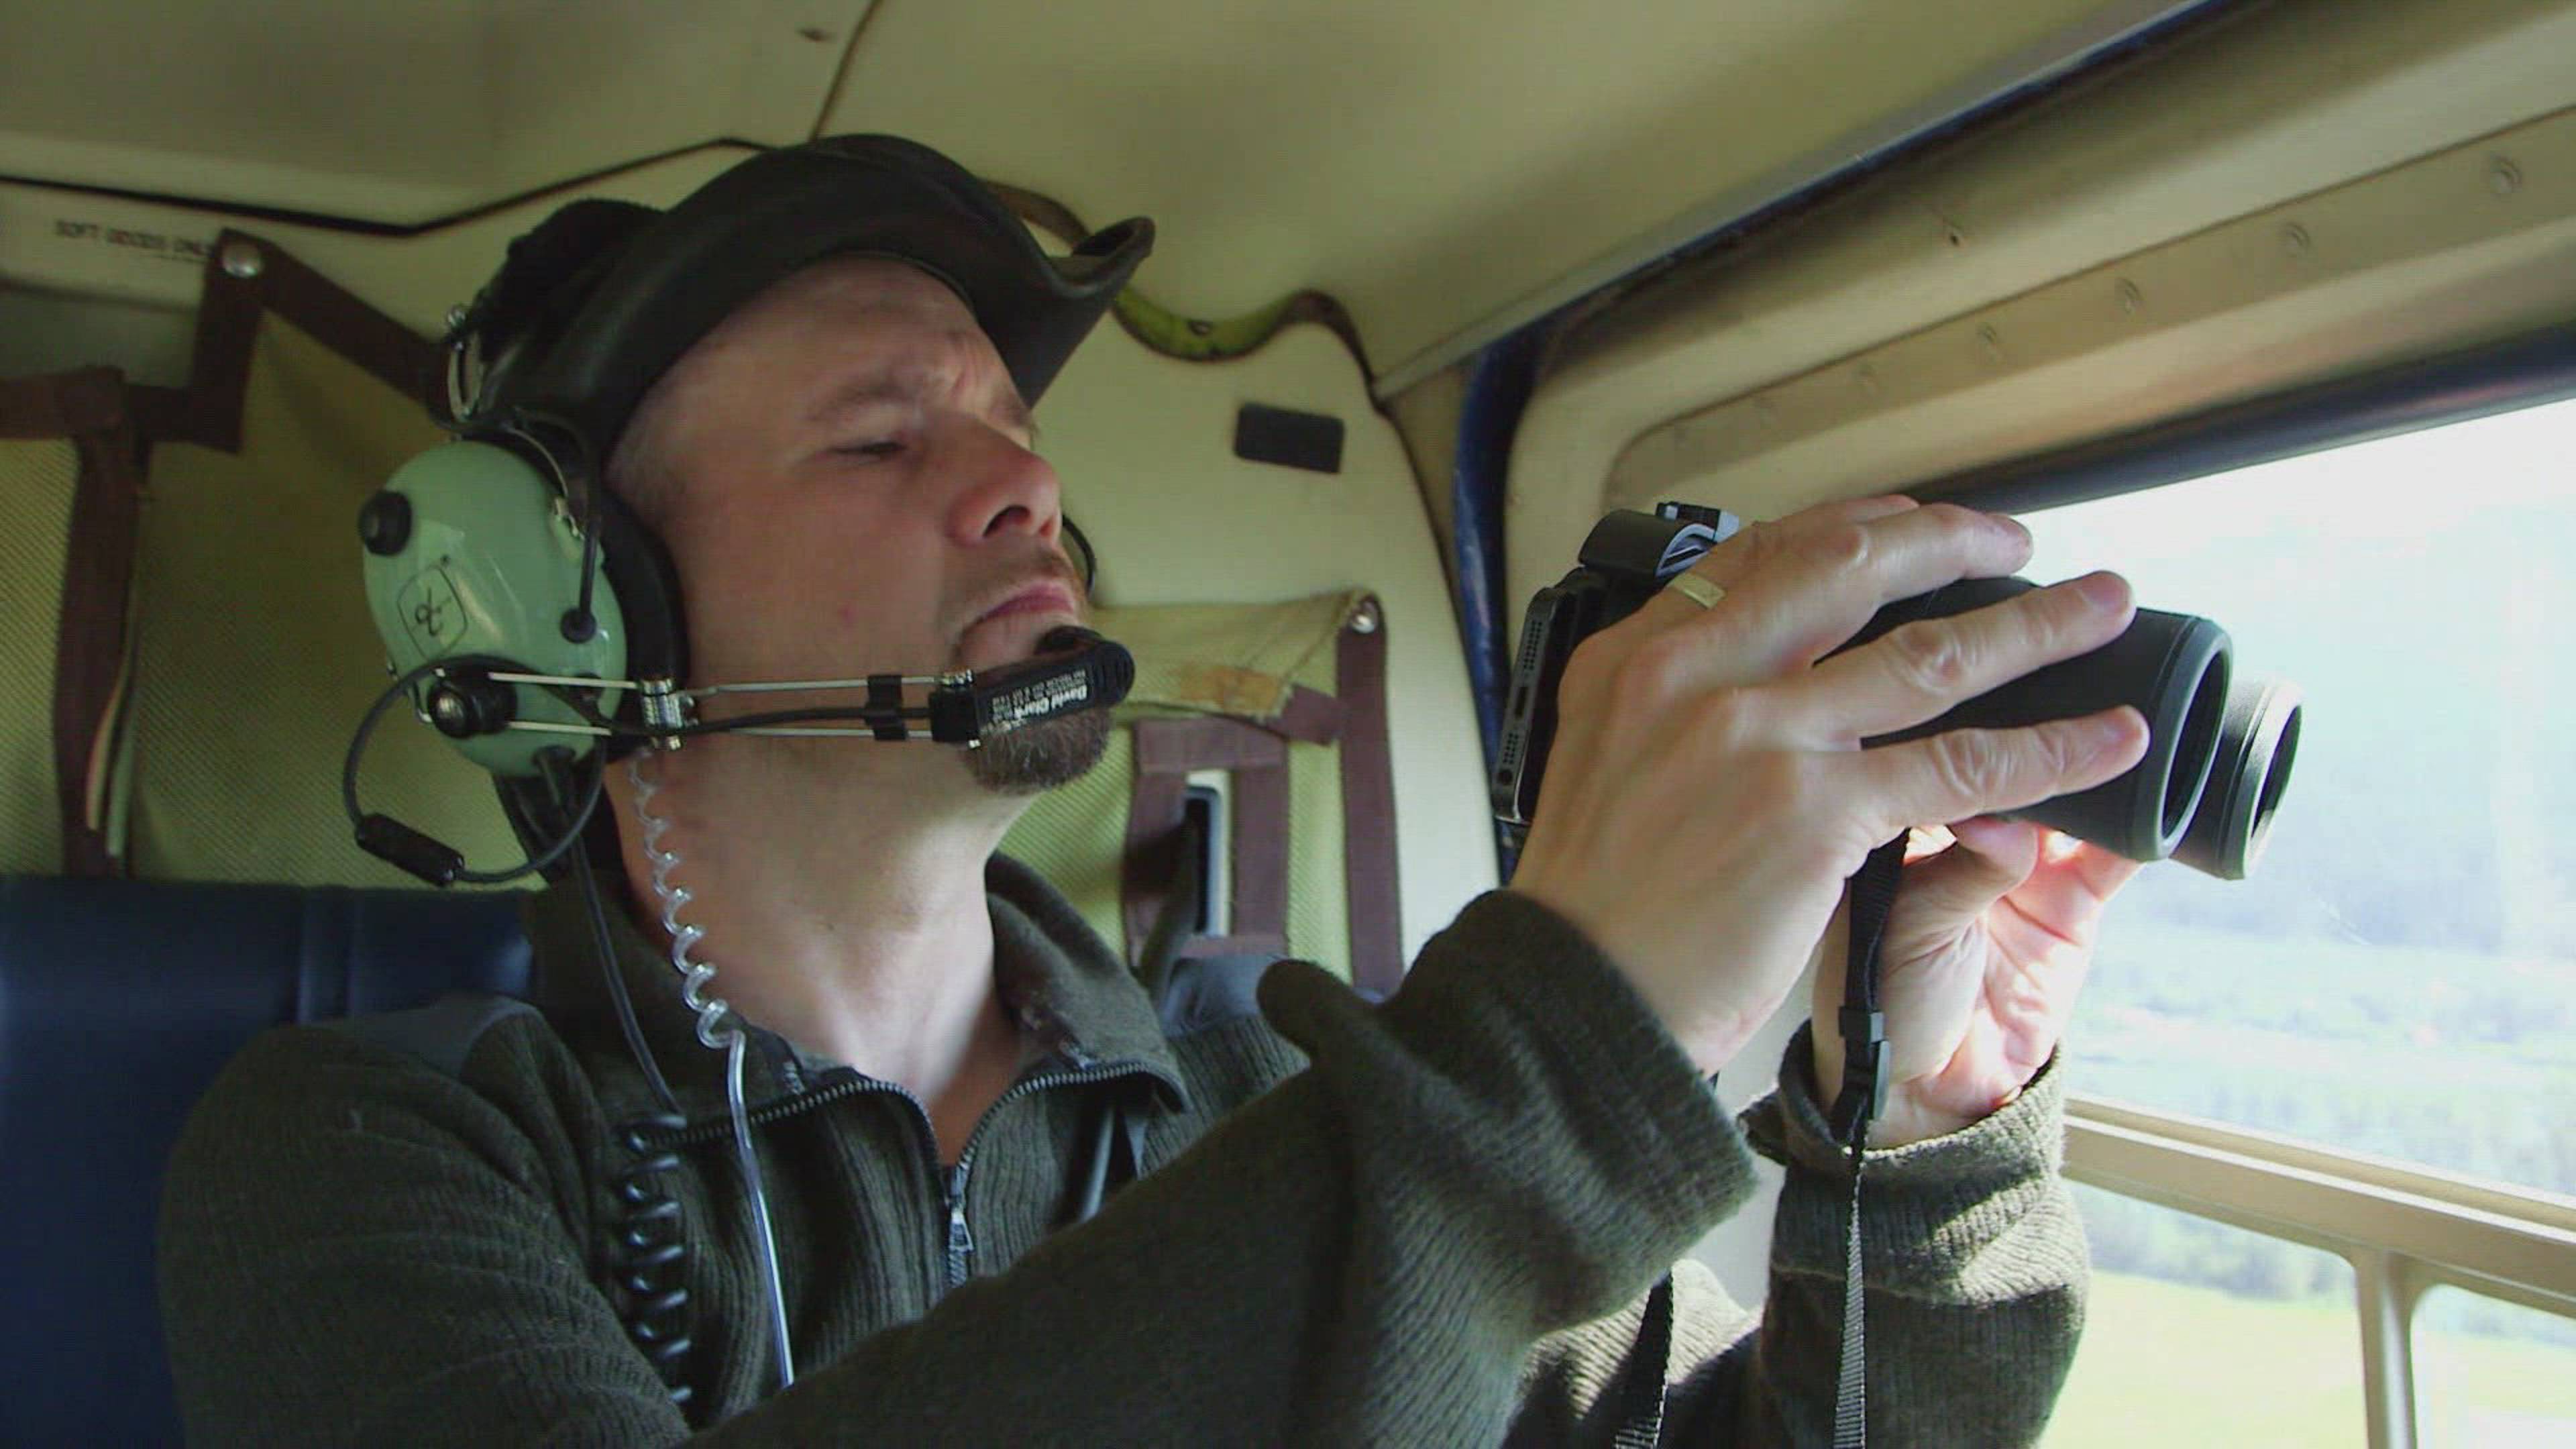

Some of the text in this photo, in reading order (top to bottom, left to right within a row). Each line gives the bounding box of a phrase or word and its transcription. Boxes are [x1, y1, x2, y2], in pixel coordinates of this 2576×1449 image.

[56, 220, 100, 239] SOFT
[107, 227, 165, 250] GOODS
[1014, 697, 1050, 718] Clark
[1051, 684, 1087, 709] David
